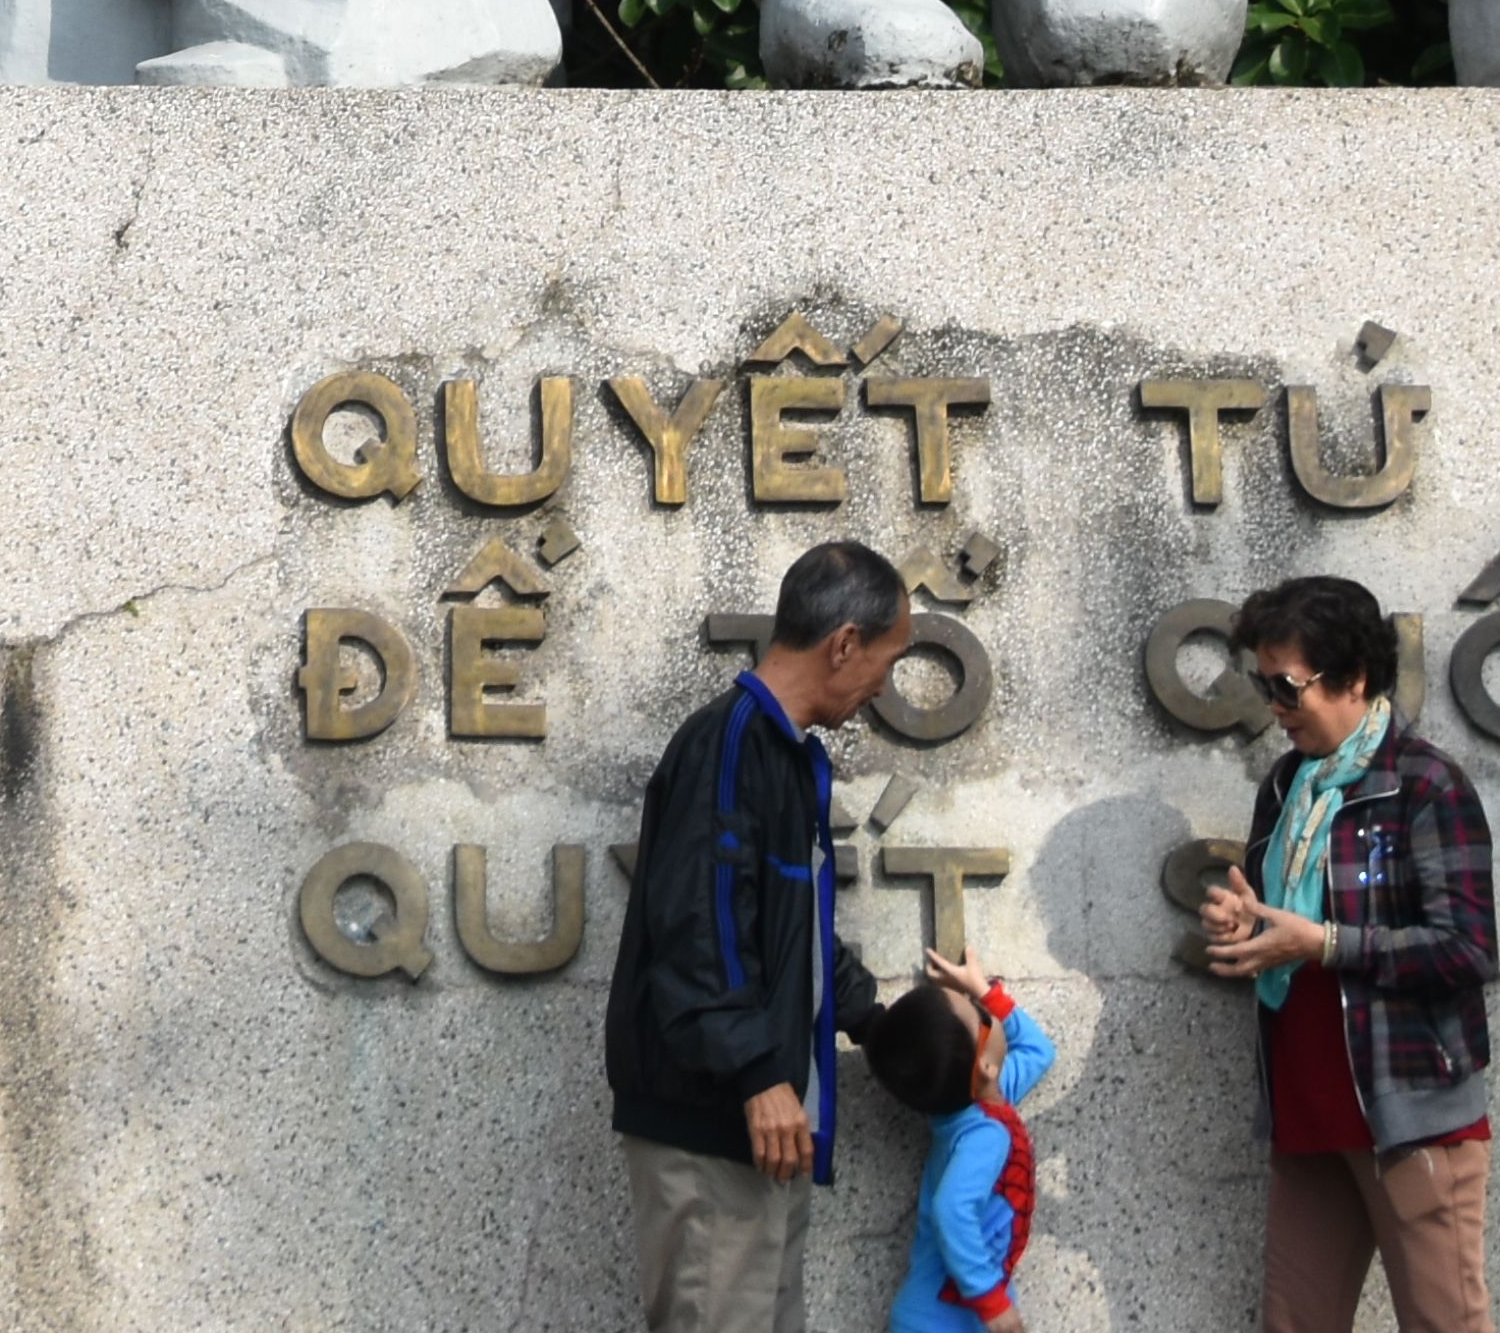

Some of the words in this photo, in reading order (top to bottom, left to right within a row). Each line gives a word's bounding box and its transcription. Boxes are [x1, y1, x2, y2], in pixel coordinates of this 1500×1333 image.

[290, 311, 992, 509] QUYẾT
[1138, 319, 1432, 511] TỬ
[298, 525, 582, 743] ĐỂ
[299, 772, 1011, 983] QUT
